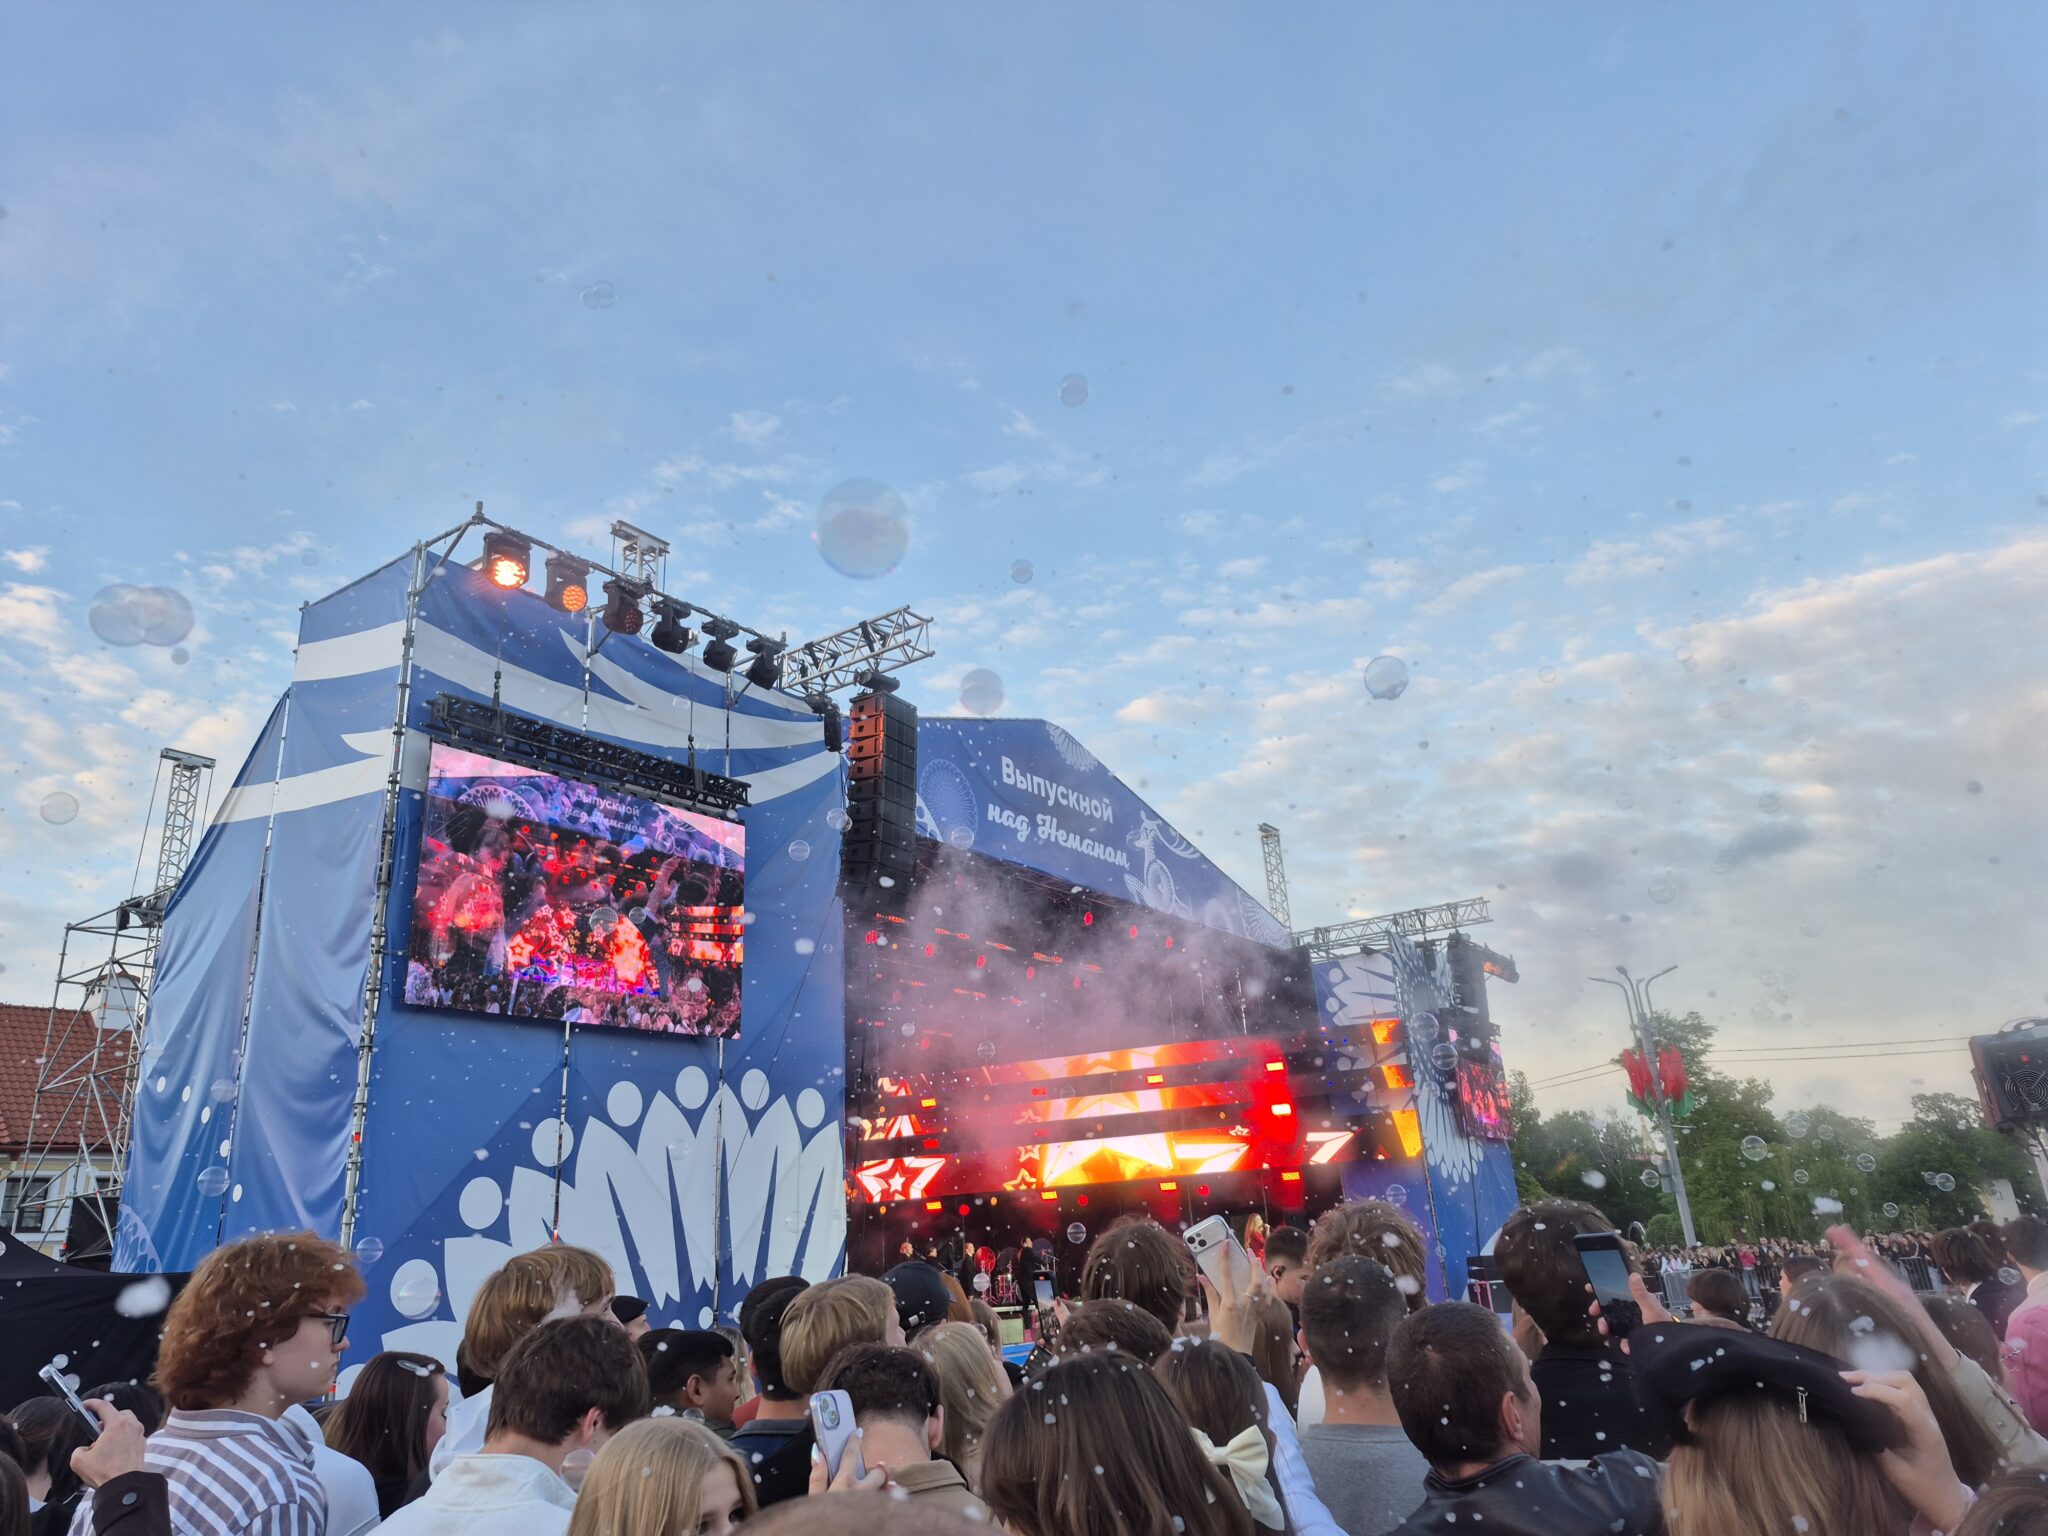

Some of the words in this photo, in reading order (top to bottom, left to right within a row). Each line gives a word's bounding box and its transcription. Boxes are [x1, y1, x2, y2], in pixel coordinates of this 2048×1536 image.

[1001, 755, 1113, 824] Выпускной
[987, 803, 1031, 842] над
[1036, 813, 1130, 868] Неманом
